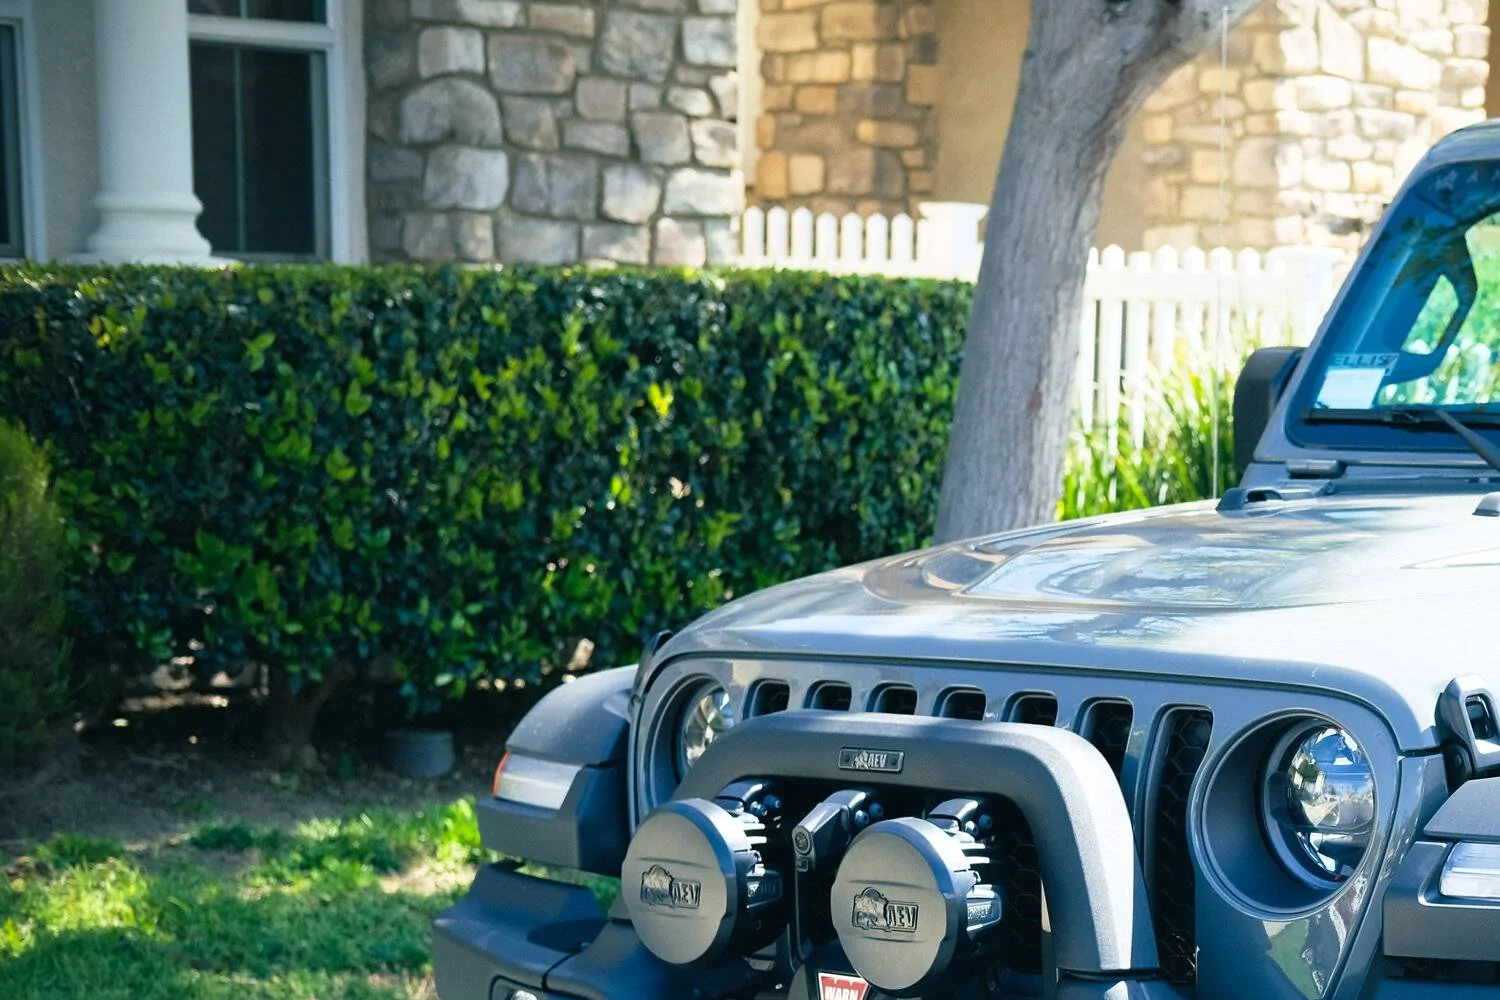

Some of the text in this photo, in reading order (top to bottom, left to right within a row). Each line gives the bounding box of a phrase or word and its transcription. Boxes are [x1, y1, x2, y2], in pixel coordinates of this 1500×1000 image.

[868, 753, 887, 768] AEV
[672, 881, 700, 904] AEV
[888, 904, 917, 928] AEV
